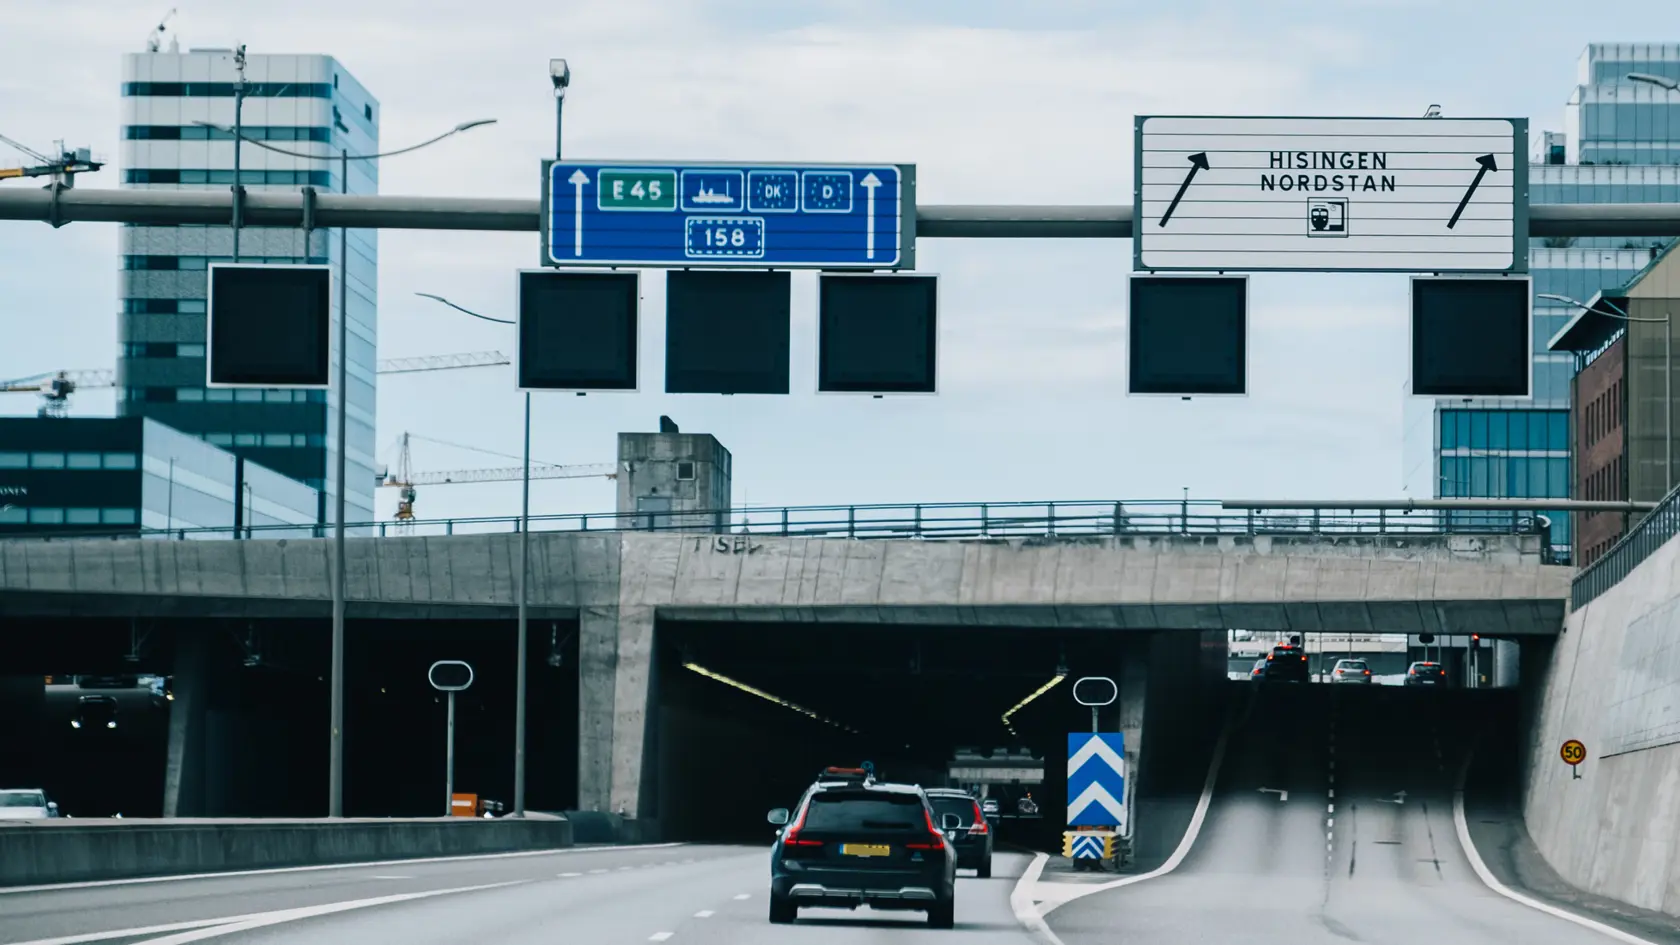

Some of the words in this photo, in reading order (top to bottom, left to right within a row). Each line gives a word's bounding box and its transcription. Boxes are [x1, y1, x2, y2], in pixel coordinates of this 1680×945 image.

[1269, 151, 1387, 170] HISINGEN
[612, 180, 624, 200] E
[630, 180, 662, 201] 45
[765, 184, 781, 199] DK
[822, 184, 833, 199] D
[1260, 174, 1396, 192] NORDSTAN
[705, 227, 745, 247] 158
[1565, 746, 1582, 759] 50
